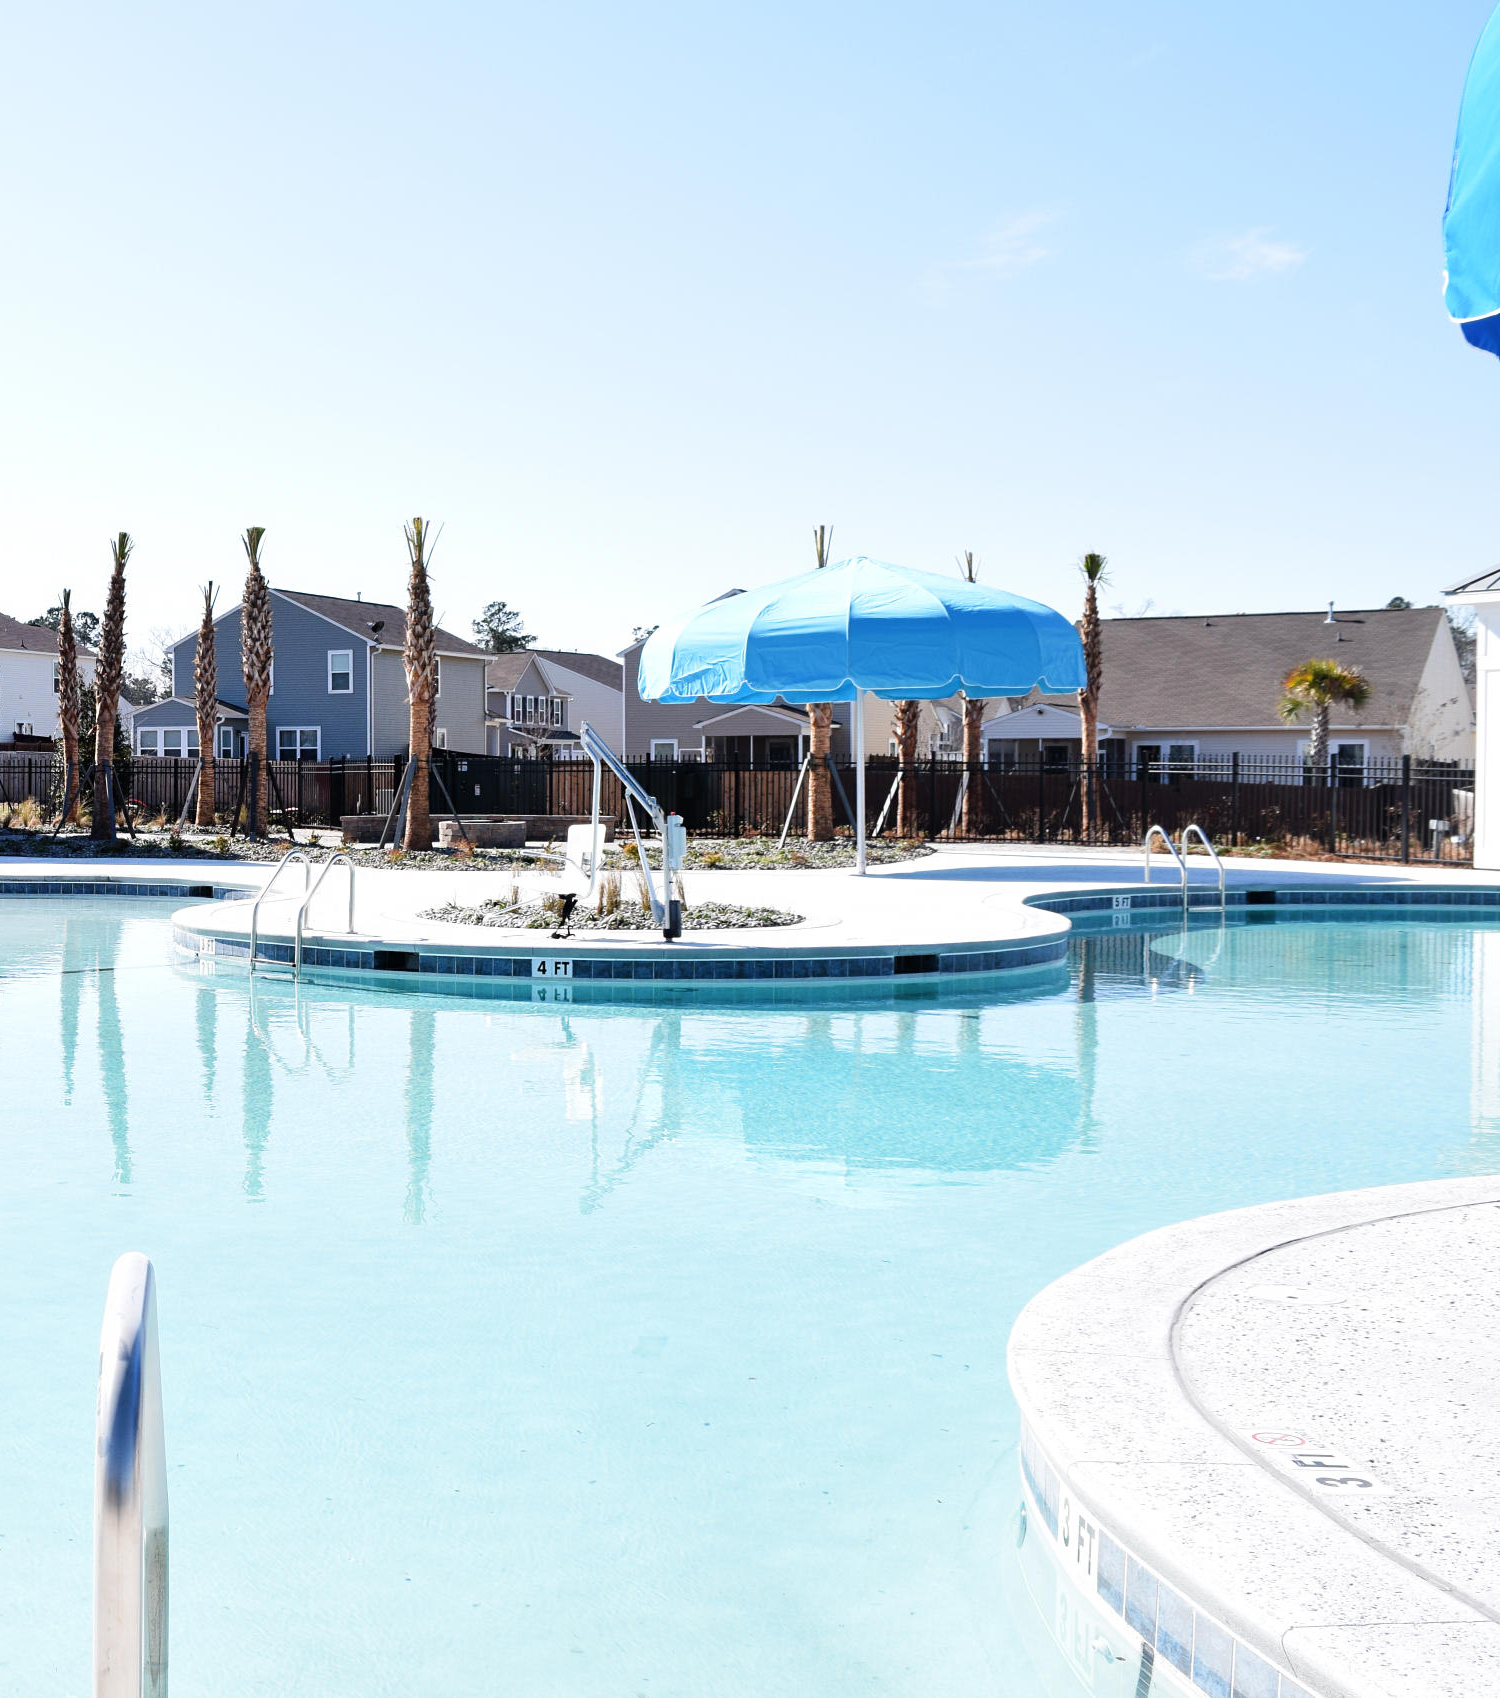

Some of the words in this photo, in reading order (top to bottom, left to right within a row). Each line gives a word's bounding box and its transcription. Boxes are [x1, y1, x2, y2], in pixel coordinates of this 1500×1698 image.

[1122, 898, 1129, 907] FT
[537, 961, 547, 975] 4
[555, 962, 569, 975] FT
[1292, 1454, 1351, 1468] FT
[1316, 1477, 1373, 1488] 3
[1063, 1497, 1070, 1547] 3
[1077, 1514, 1096, 1575] FT
